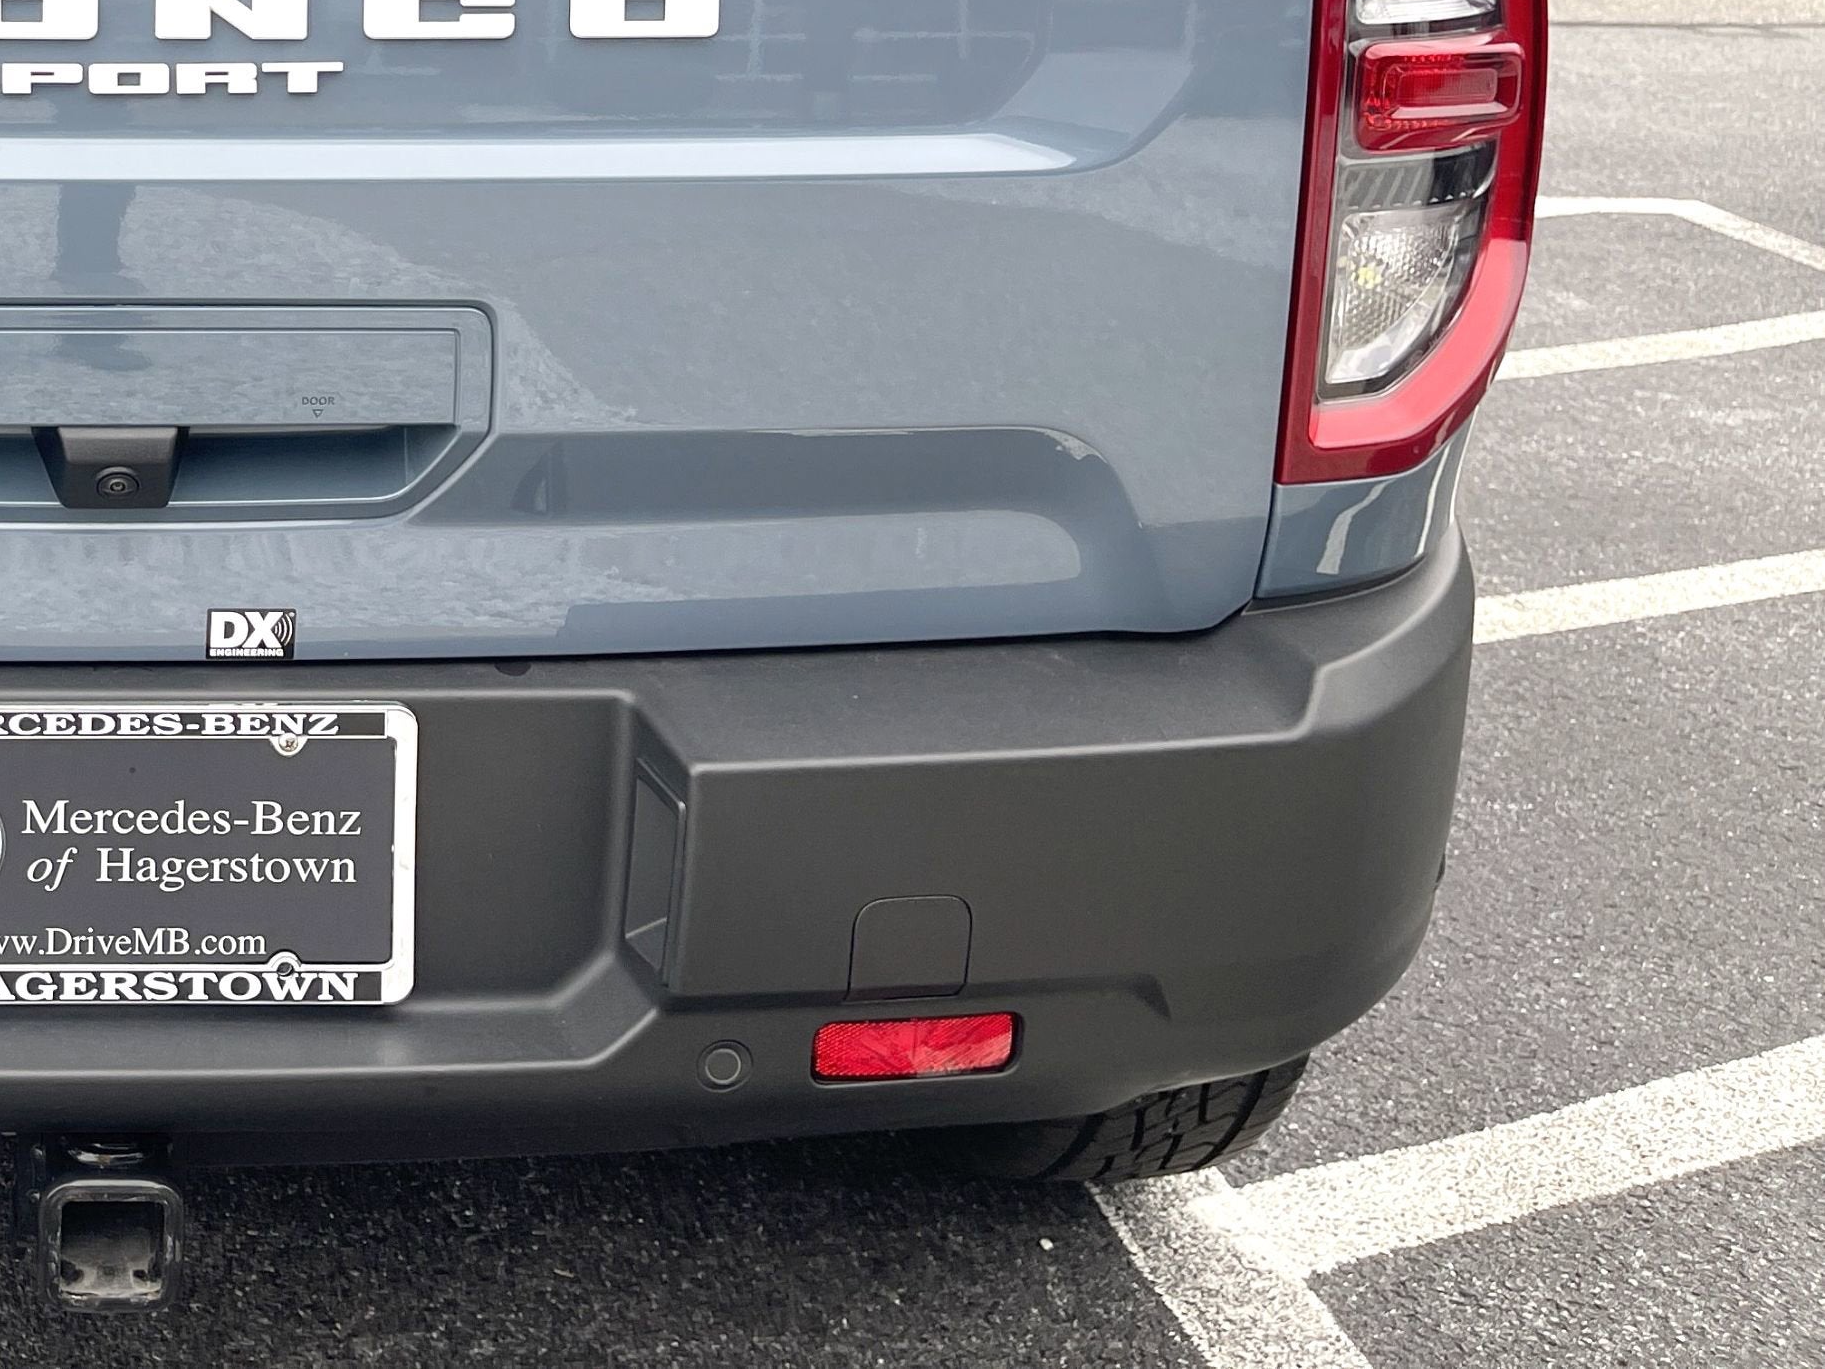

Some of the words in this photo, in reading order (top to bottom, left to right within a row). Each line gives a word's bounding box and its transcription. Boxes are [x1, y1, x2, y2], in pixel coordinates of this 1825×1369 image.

[301, 396, 335, 406] DOOR
[209, 611, 284, 648] DX
[209, 648, 284, 657] ENGINEERING
[22, 799, 363, 836] Mercedes-Benz
[26, 847, 78, 891] of
[97, 847, 358, 891] Hagerstown
